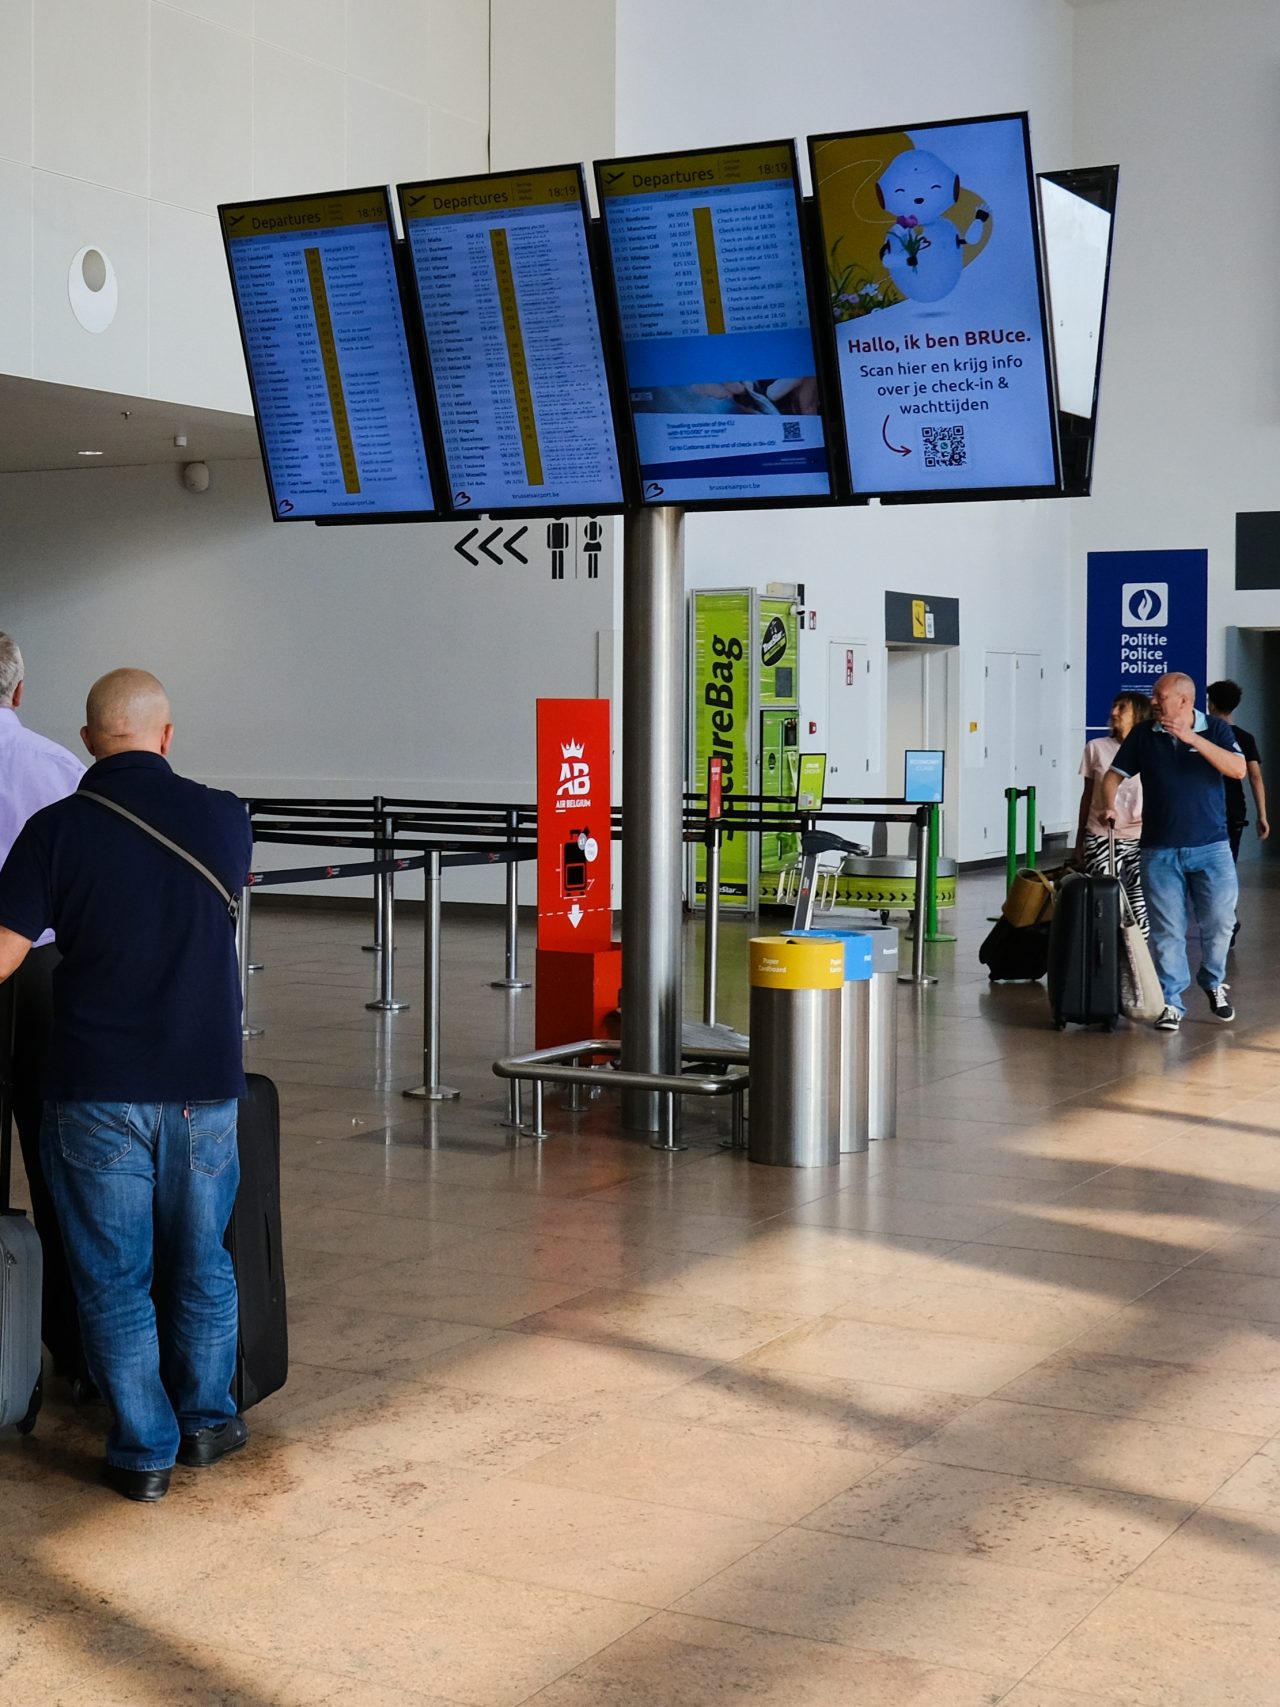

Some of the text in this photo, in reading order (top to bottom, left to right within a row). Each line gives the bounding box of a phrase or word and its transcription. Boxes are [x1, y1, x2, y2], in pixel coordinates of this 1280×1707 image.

[632, 168, 714, 188] Departures
[758, 162, 788, 175] 18:19
[432, 191, 508, 210] Departures
[548, 186, 576, 198] 18:19
[252, 212, 320, 230] Departures
[357, 207, 384, 218] 18:19
[848, 329, 1031, 353] Hallo, ik ben BRUce.
[860, 354, 1023, 378] Scan hier en krijg info
[877, 376, 1009, 397] over je check-in &
[900, 399, 989, 415] wachttijden
[1121, 633, 1168, 646] Politie
[1121, 648, 1163, 660] Police
[1120, 661, 1168, 674] Polizei
[566, 799, 592, 808] BELGIUM
